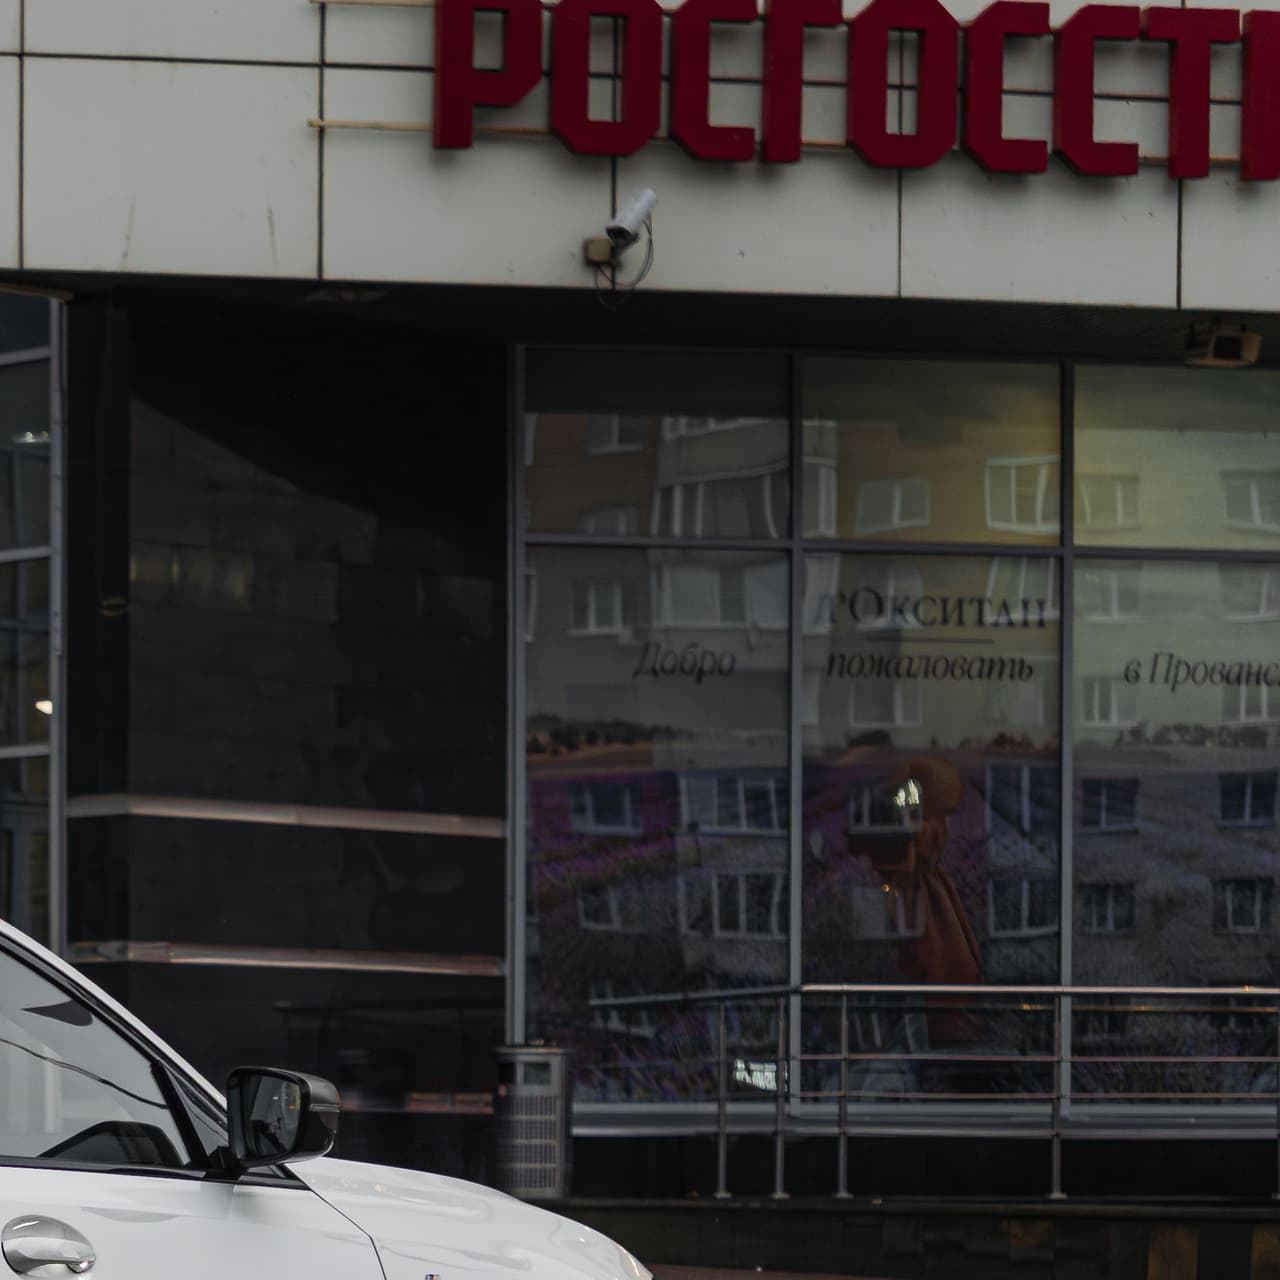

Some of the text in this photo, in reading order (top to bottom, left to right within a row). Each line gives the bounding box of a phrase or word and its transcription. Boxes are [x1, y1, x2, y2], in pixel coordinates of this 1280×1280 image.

[633, 642, 1280, 694] Добро пожаловать в Прованс
